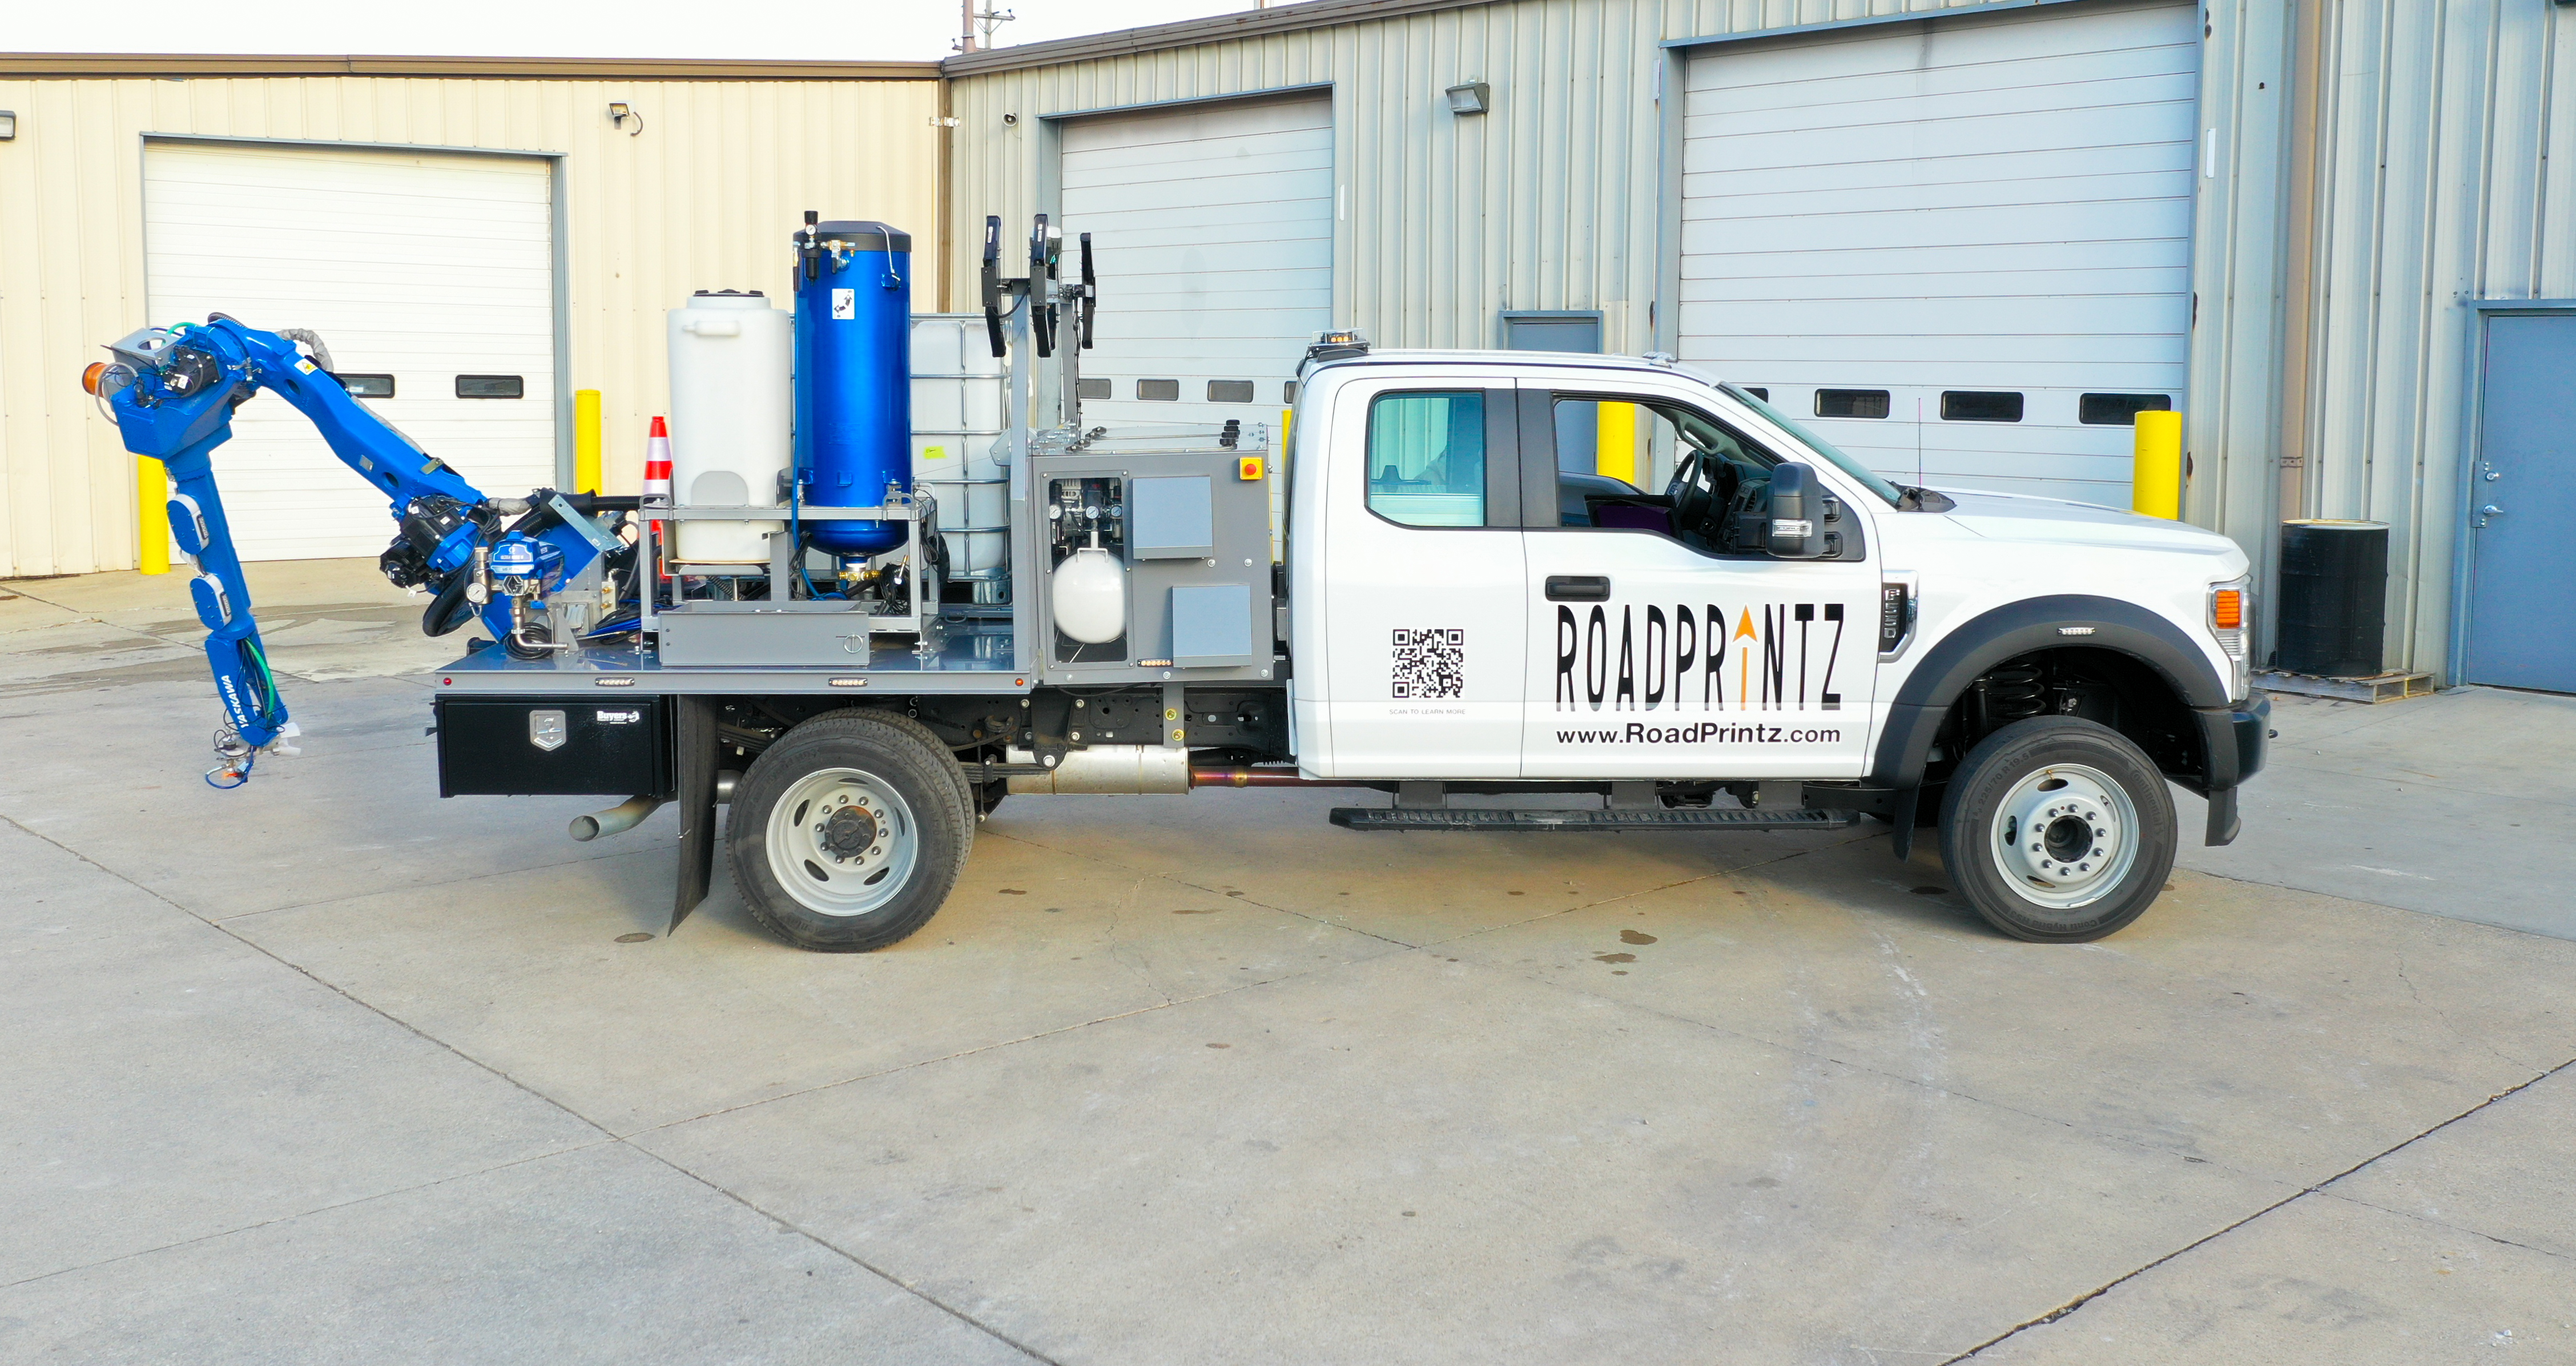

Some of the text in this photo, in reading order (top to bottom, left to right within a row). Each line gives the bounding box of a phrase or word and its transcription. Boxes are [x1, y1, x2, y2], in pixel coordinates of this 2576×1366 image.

[1883, 588, 1901, 639] F550
[1556, 604, 1844, 712] ROADPRINTZ
[220, 674, 249, 728] YASKAWA
[597, 710, 627, 721] Buyers
[1556, 722, 1841, 744] www.RoadPrintz.com
[1978, 772, 2003, 806] 225/70
[2130, 769, 2163, 826] Continental
[2032, 919, 2067, 931] Hybrid
[2070, 919, 2098, 930] Conti
